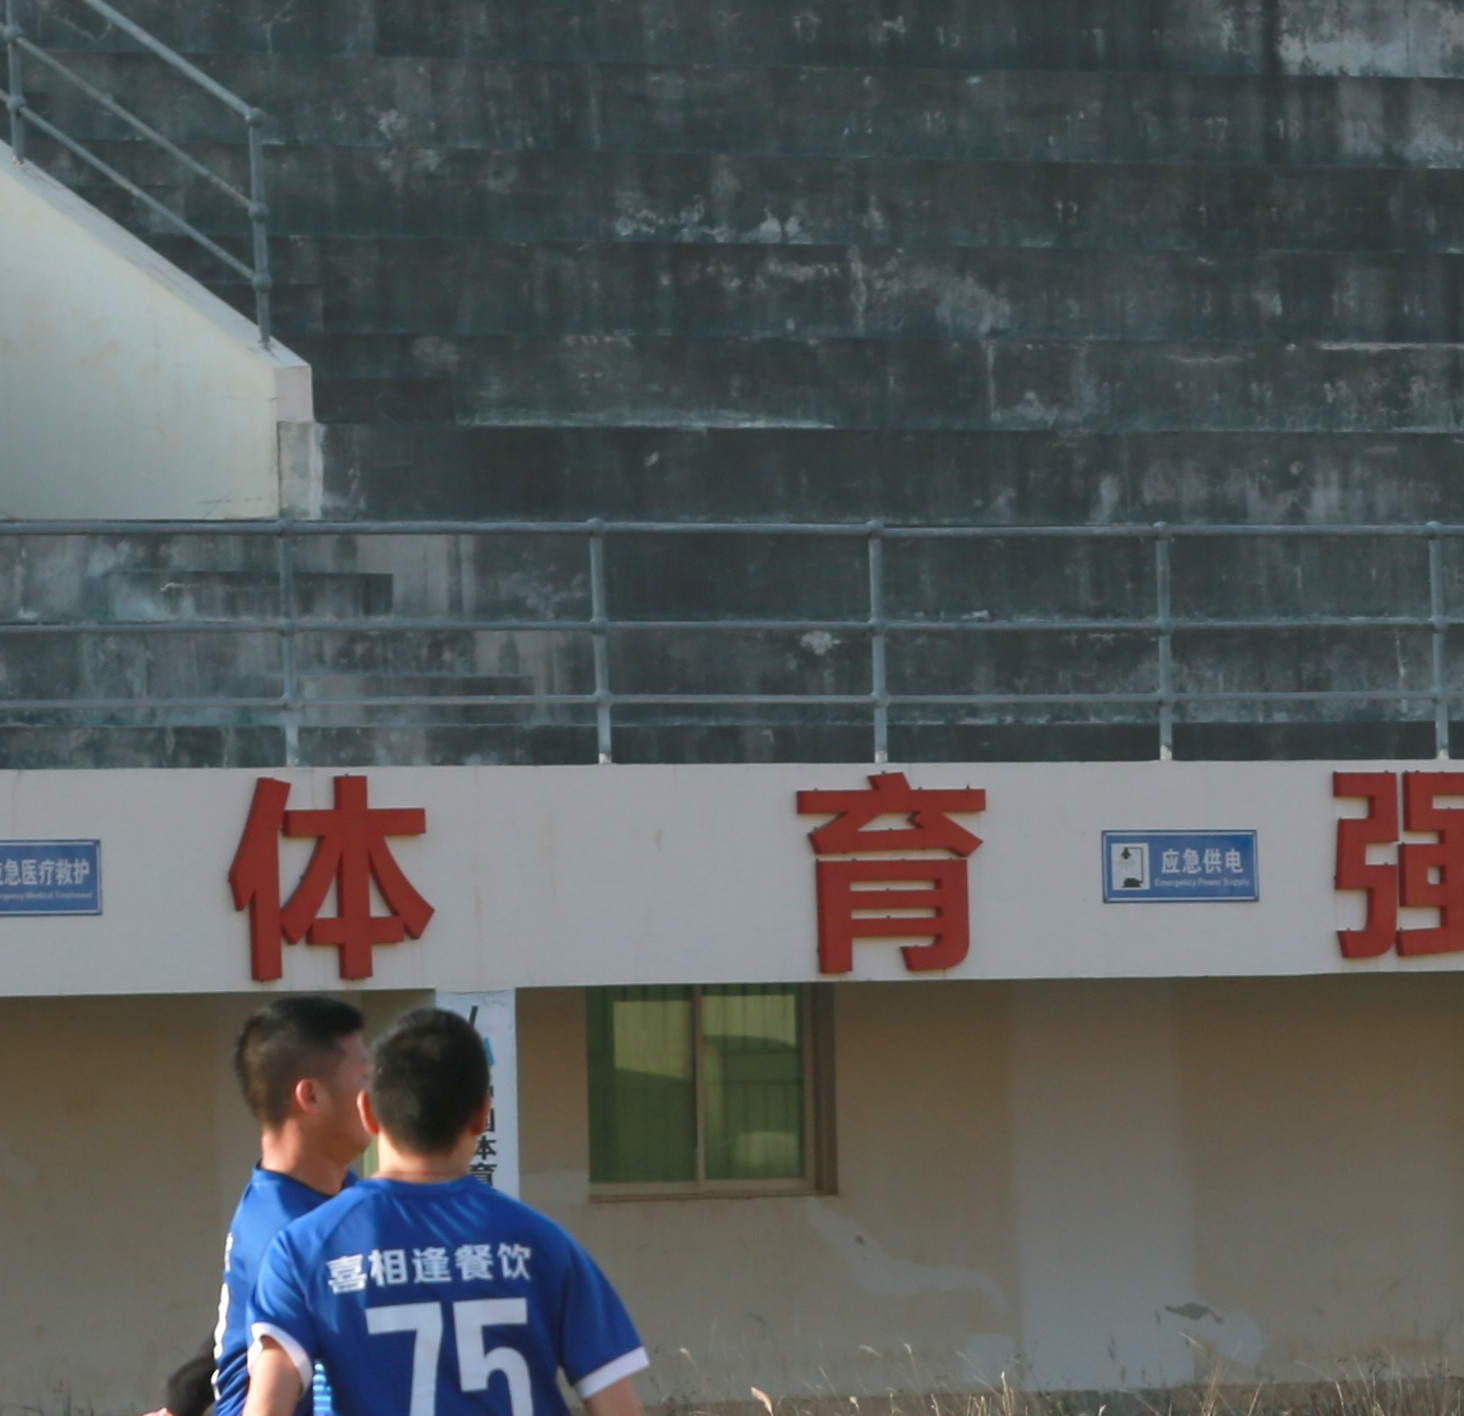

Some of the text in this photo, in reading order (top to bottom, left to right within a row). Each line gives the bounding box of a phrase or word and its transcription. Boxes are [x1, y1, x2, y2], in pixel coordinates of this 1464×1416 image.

[1161, 848, 1244, 874] 应急供电
[326, 1242, 534, 1295] 喜相逢餐饮
